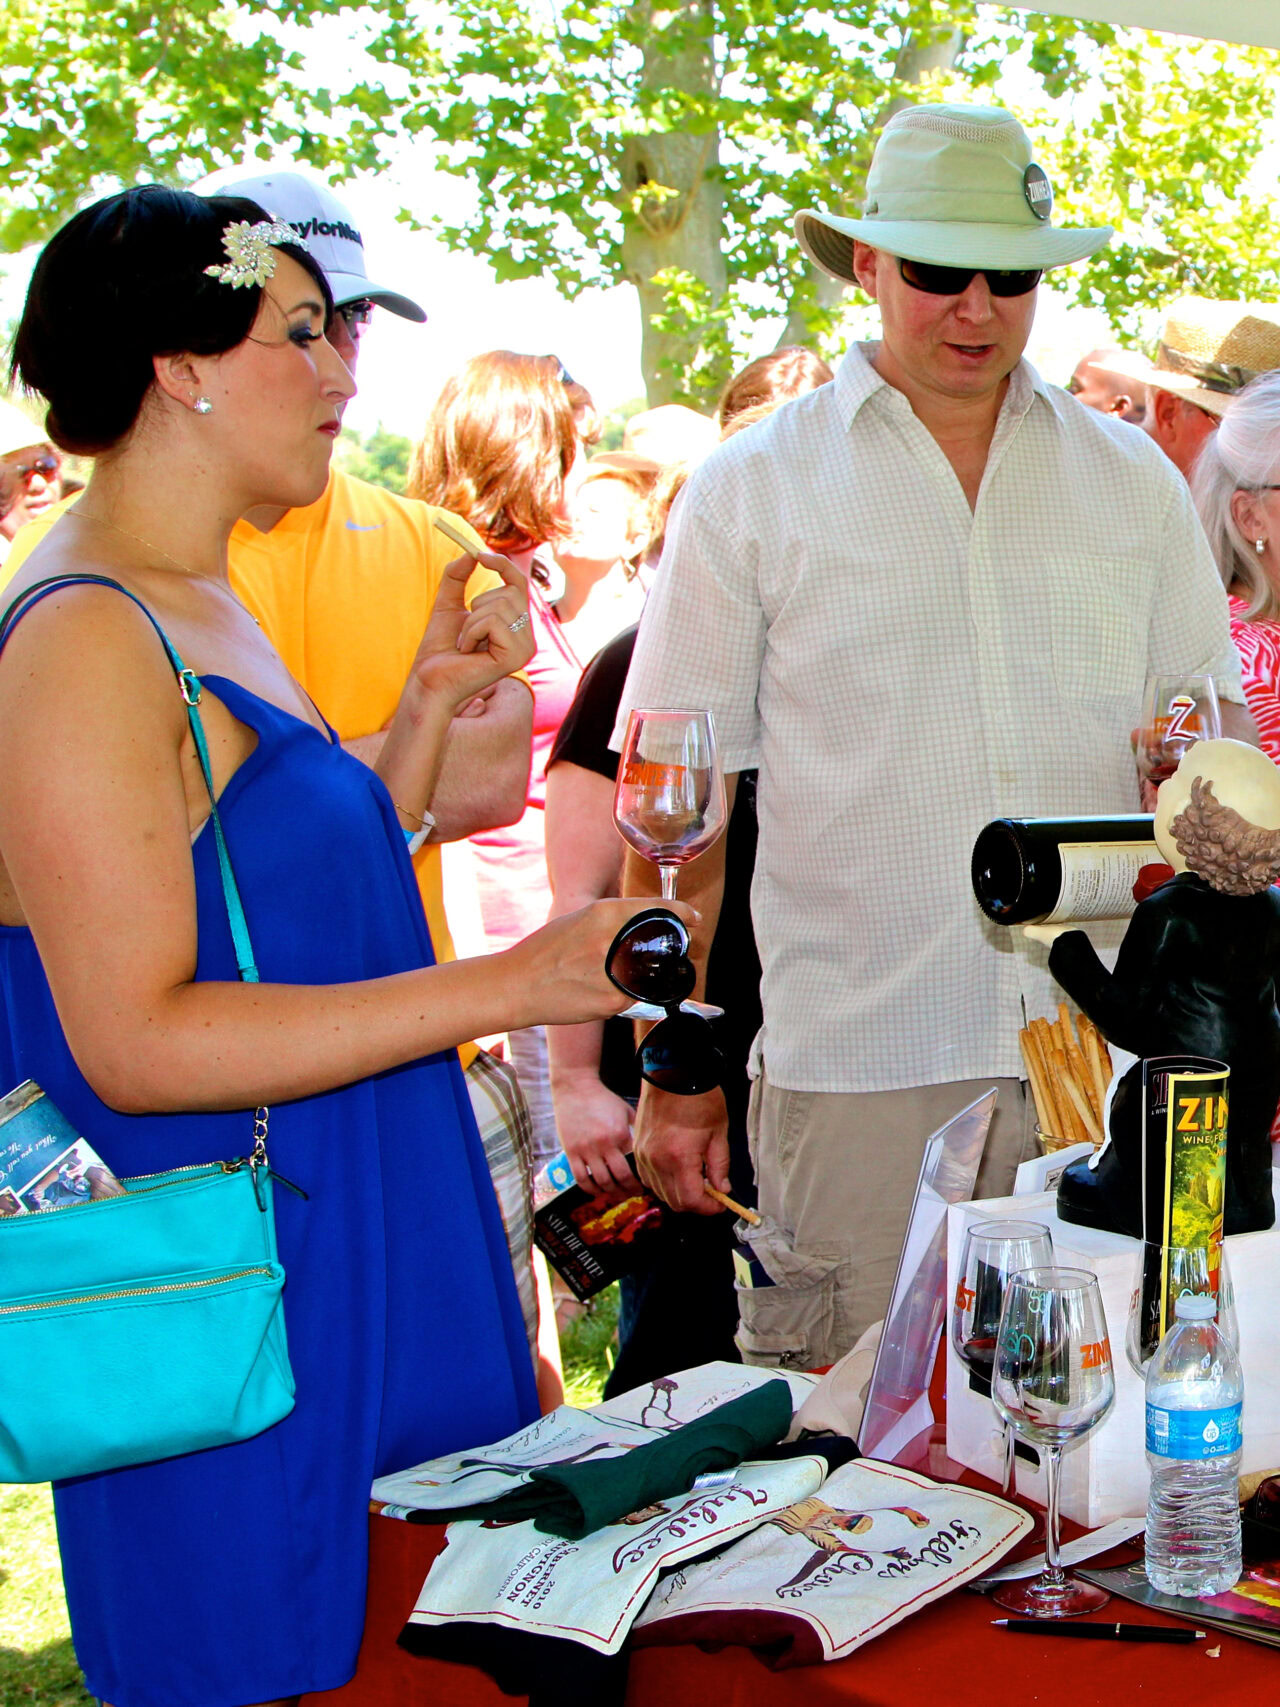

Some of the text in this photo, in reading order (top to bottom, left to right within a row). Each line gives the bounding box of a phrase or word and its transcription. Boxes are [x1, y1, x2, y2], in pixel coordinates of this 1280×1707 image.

[622, 762, 687, 787] ZINFEST
[494, 1547, 541, 1600] CALIFORNIA
[520, 1546, 579, 1608] CABERNET
[532, 1580, 556, 1610] 2010
